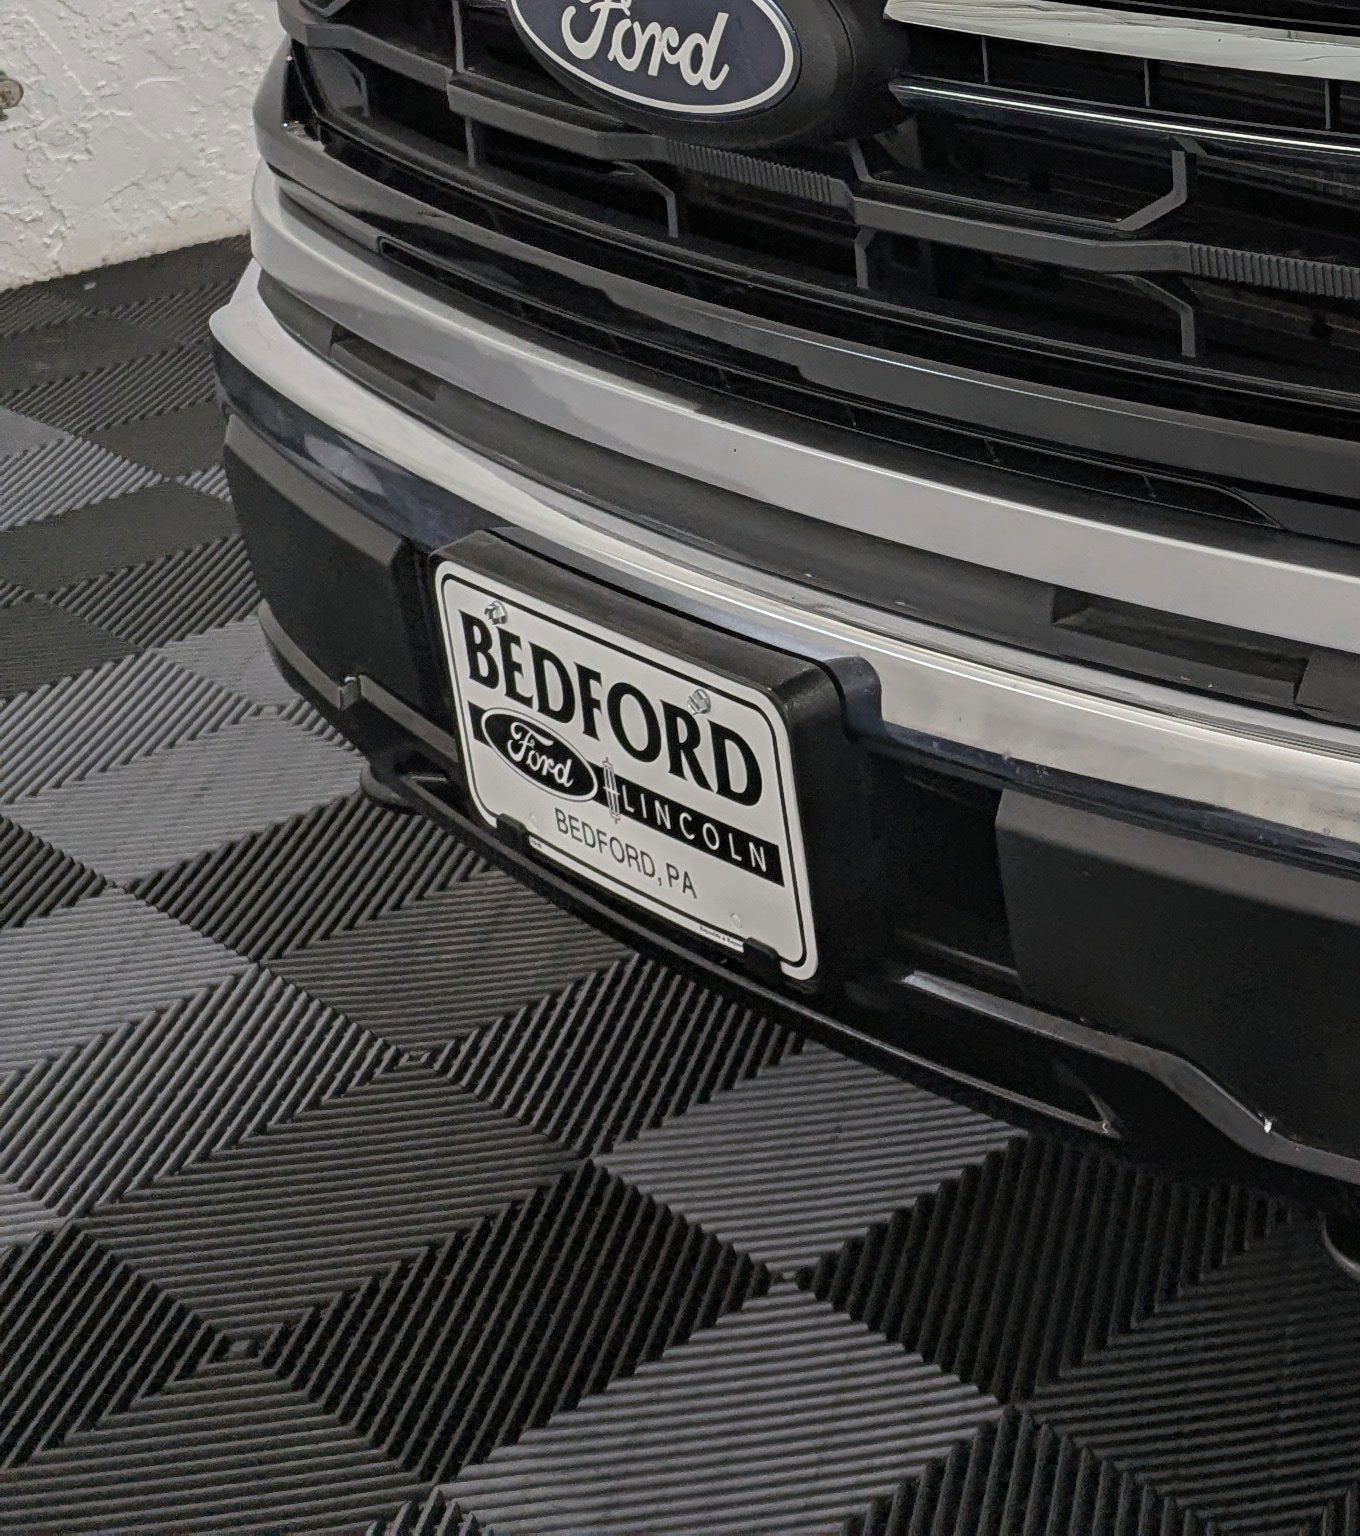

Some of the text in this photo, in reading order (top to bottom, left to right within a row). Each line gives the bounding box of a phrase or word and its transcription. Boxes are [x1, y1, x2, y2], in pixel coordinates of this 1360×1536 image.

[457, 609, 763, 807] BEDFORD
[506, 720, 574, 790] Ford
[555, 807, 698, 900] BEDFORD, PA
[624, 786, 767, 872] LINCOLN
